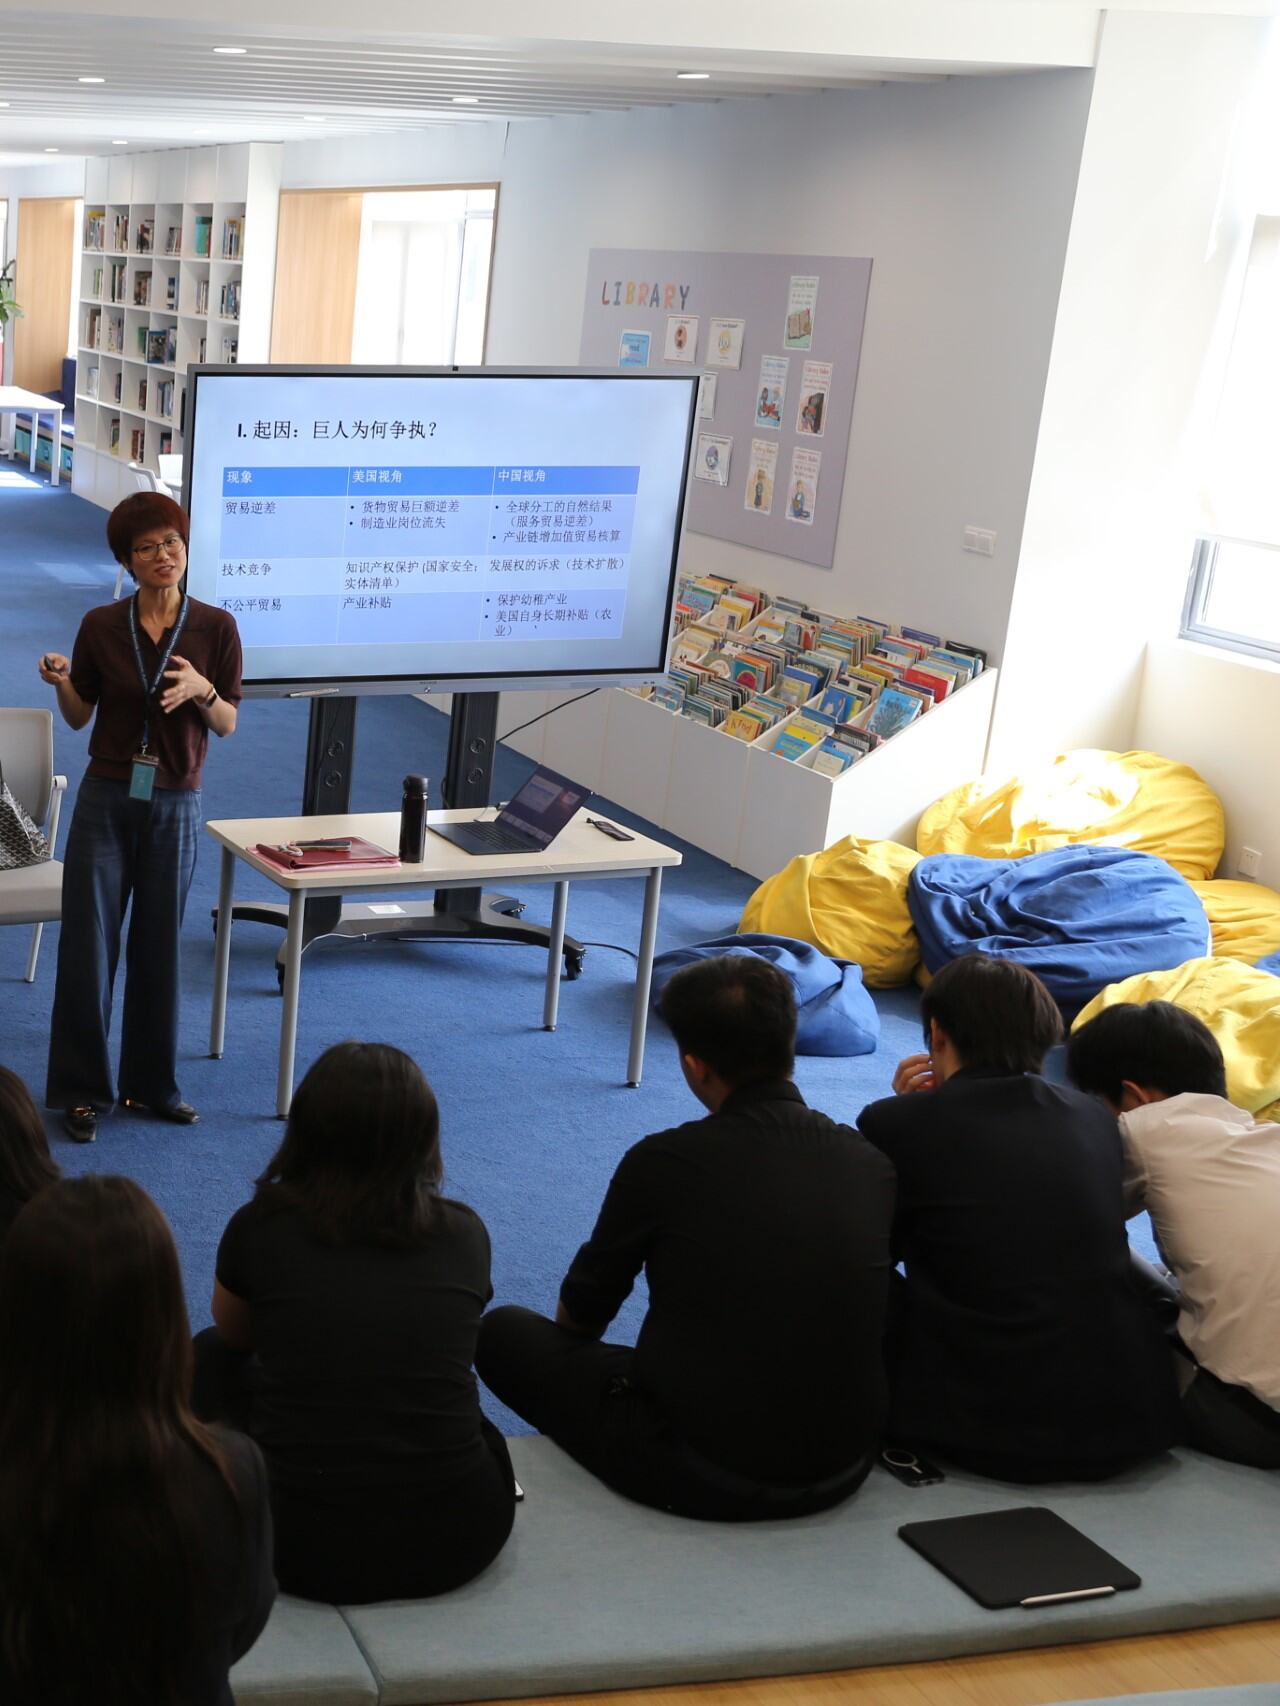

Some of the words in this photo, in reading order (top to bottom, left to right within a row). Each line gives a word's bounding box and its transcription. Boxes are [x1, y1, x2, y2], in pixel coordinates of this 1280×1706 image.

[601, 281, 690, 310] LIBRARY
[227, 471, 253, 484] 现象
[352, 470, 402, 483] 美国视角
[498, 470, 546, 482] 中国视角
[225, 501, 276, 515] 贸易逆差
[361, 500, 460, 513] 货物贸易巨额逆差
[506, 500, 613, 513] 全球分工的自然结果
[360, 517, 446, 530] 制造业岗位流失
[503, 530, 621, 543] 产业链增加值贸易核算
[222, 563, 272, 577] 技术竞争
[220, 599, 282, 612] 不公平贸易
[342, 596, 392, 610] 产业补贴
[498, 593, 567, 606] 保护幼稚产业
